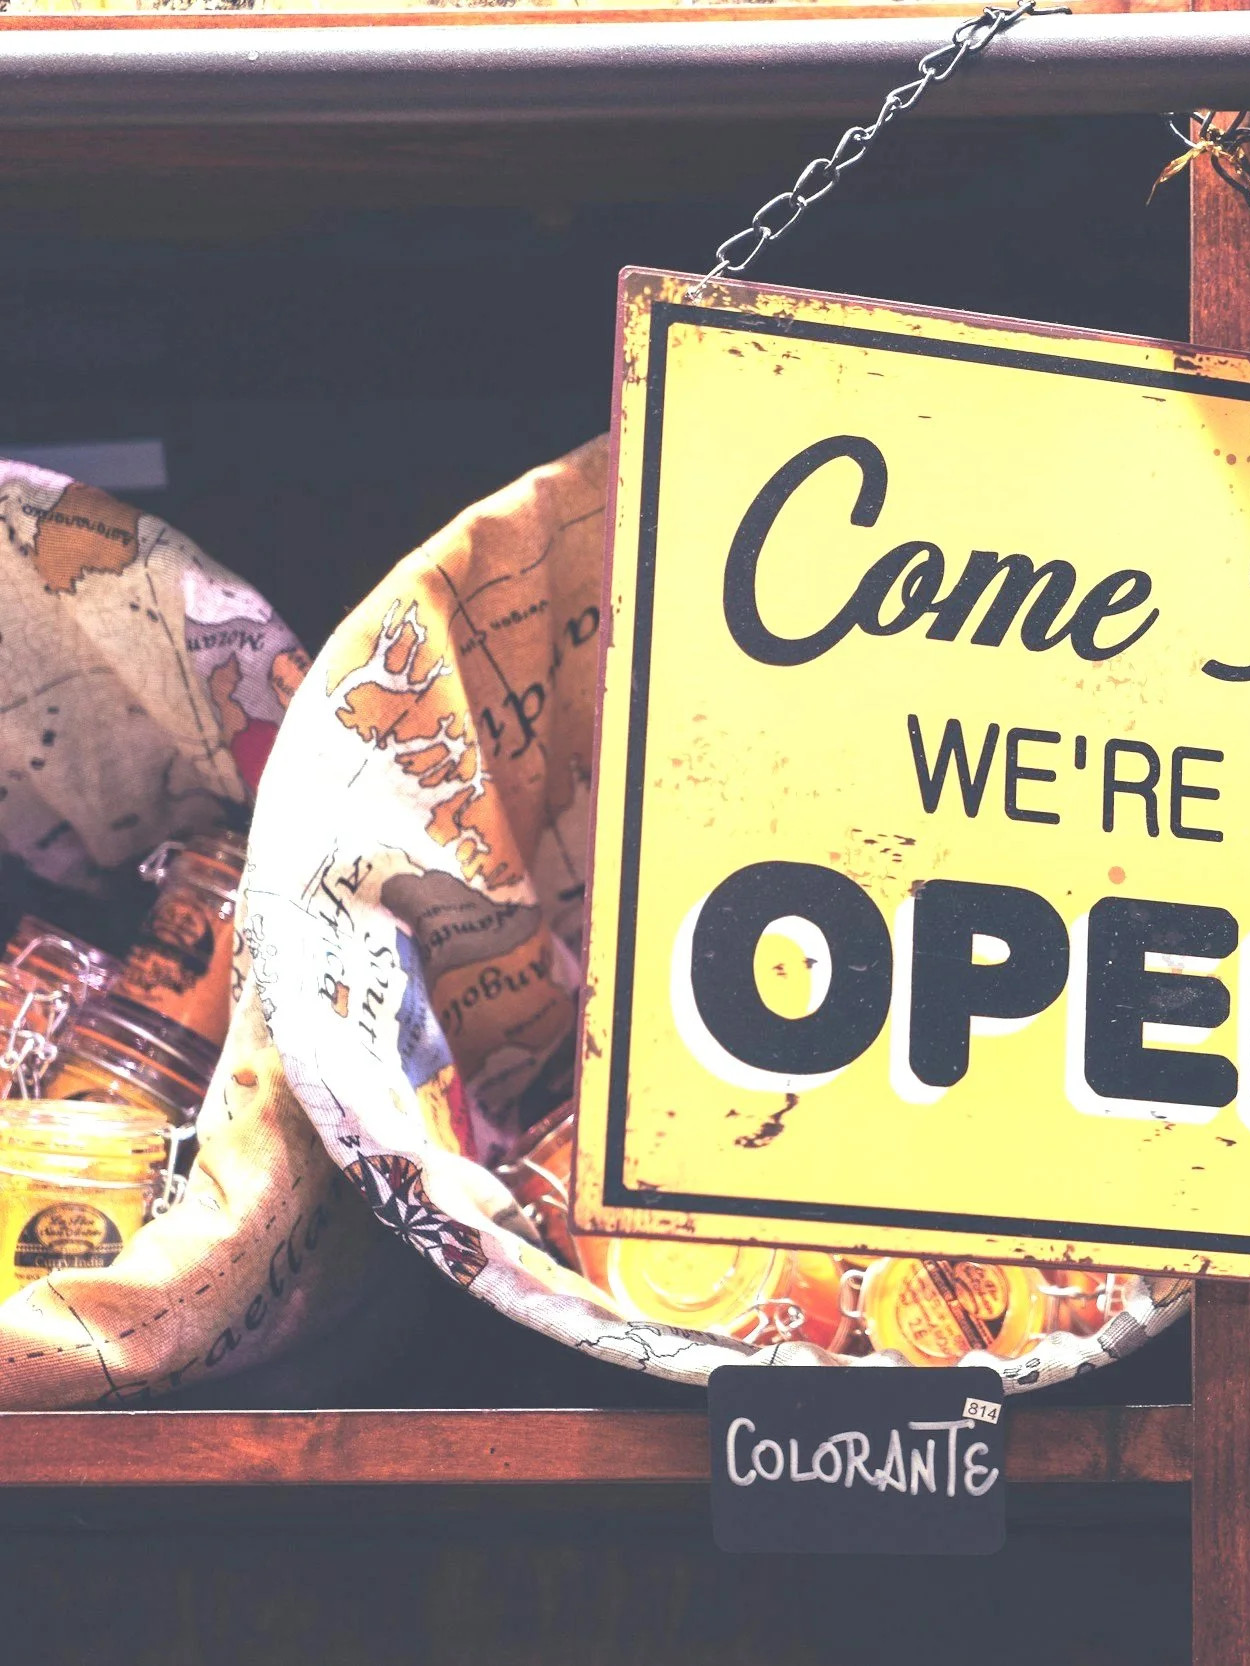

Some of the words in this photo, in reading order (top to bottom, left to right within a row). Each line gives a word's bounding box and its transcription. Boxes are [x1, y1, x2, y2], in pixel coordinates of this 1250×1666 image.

[724, 436, 1159, 666] Come
[908, 714, 1224, 842] WE'RE
[726, 1417, 999, 1496] COLORANTE
[967, 1402, 998, 1421] 814
